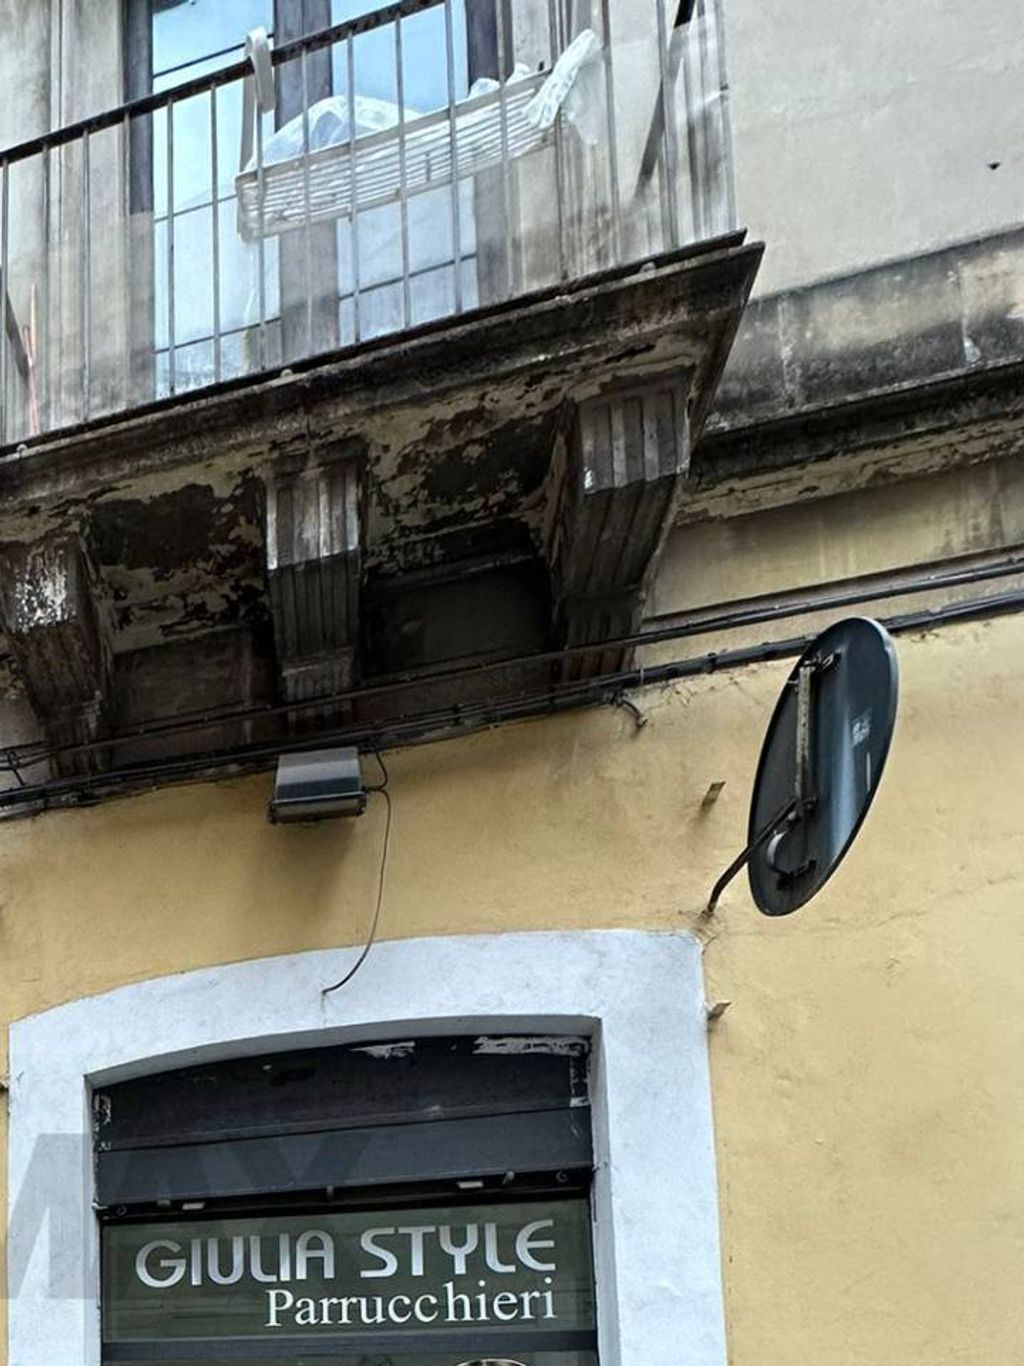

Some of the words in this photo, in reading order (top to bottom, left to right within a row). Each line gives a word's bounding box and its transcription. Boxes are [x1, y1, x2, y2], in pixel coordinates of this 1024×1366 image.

[135, 1229, 335, 1288] GIULIA
[360, 1219, 556, 1278] STYLE
[264, 1276, 557, 1327] Parrucchieri
